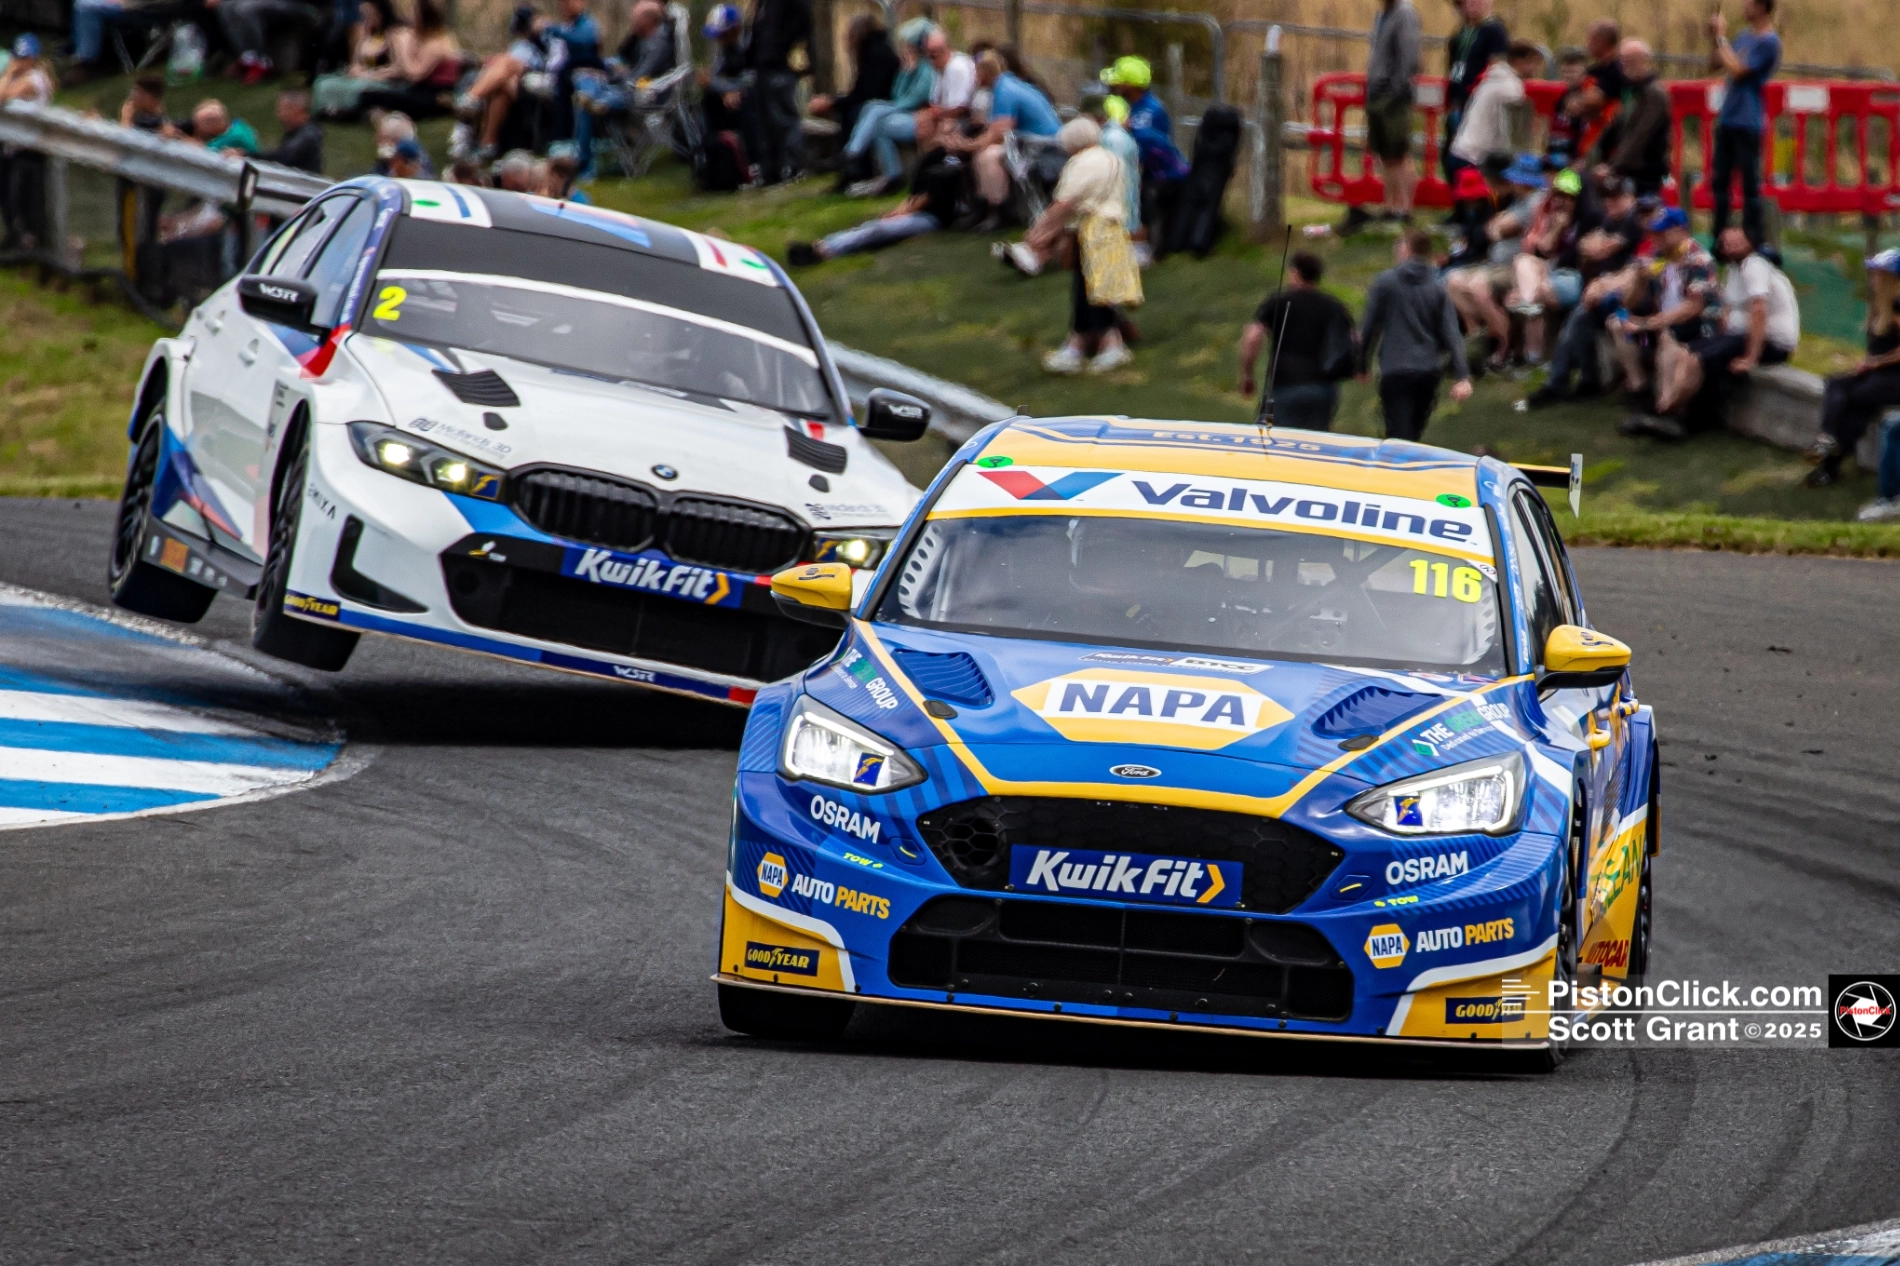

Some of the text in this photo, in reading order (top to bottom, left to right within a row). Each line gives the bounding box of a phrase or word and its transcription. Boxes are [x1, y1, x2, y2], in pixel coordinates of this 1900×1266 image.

[372, 286, 407, 320] 2
[1131, 480, 1473, 543] Valvoline
[1410, 559, 1482, 603] 116
[865, 677, 899, 709] GROUP
[1058, 683, 1245, 726] NAPA
[1420, 722, 1455, 745] THE
[1476, 702, 1513, 721] GROUP
[1121, 766, 1150, 776] Ford
[810, 795, 881, 844] OSRAM
[843, 852, 873, 867] TOW
[1385, 850, 1469, 885] OSRAM
[760, 862, 891, 919] NAPA AUTO PARTS
[1387, 895, 1419, 907] TOW
[1372, 917, 1515, 957] NAPA AUTO PARTS
